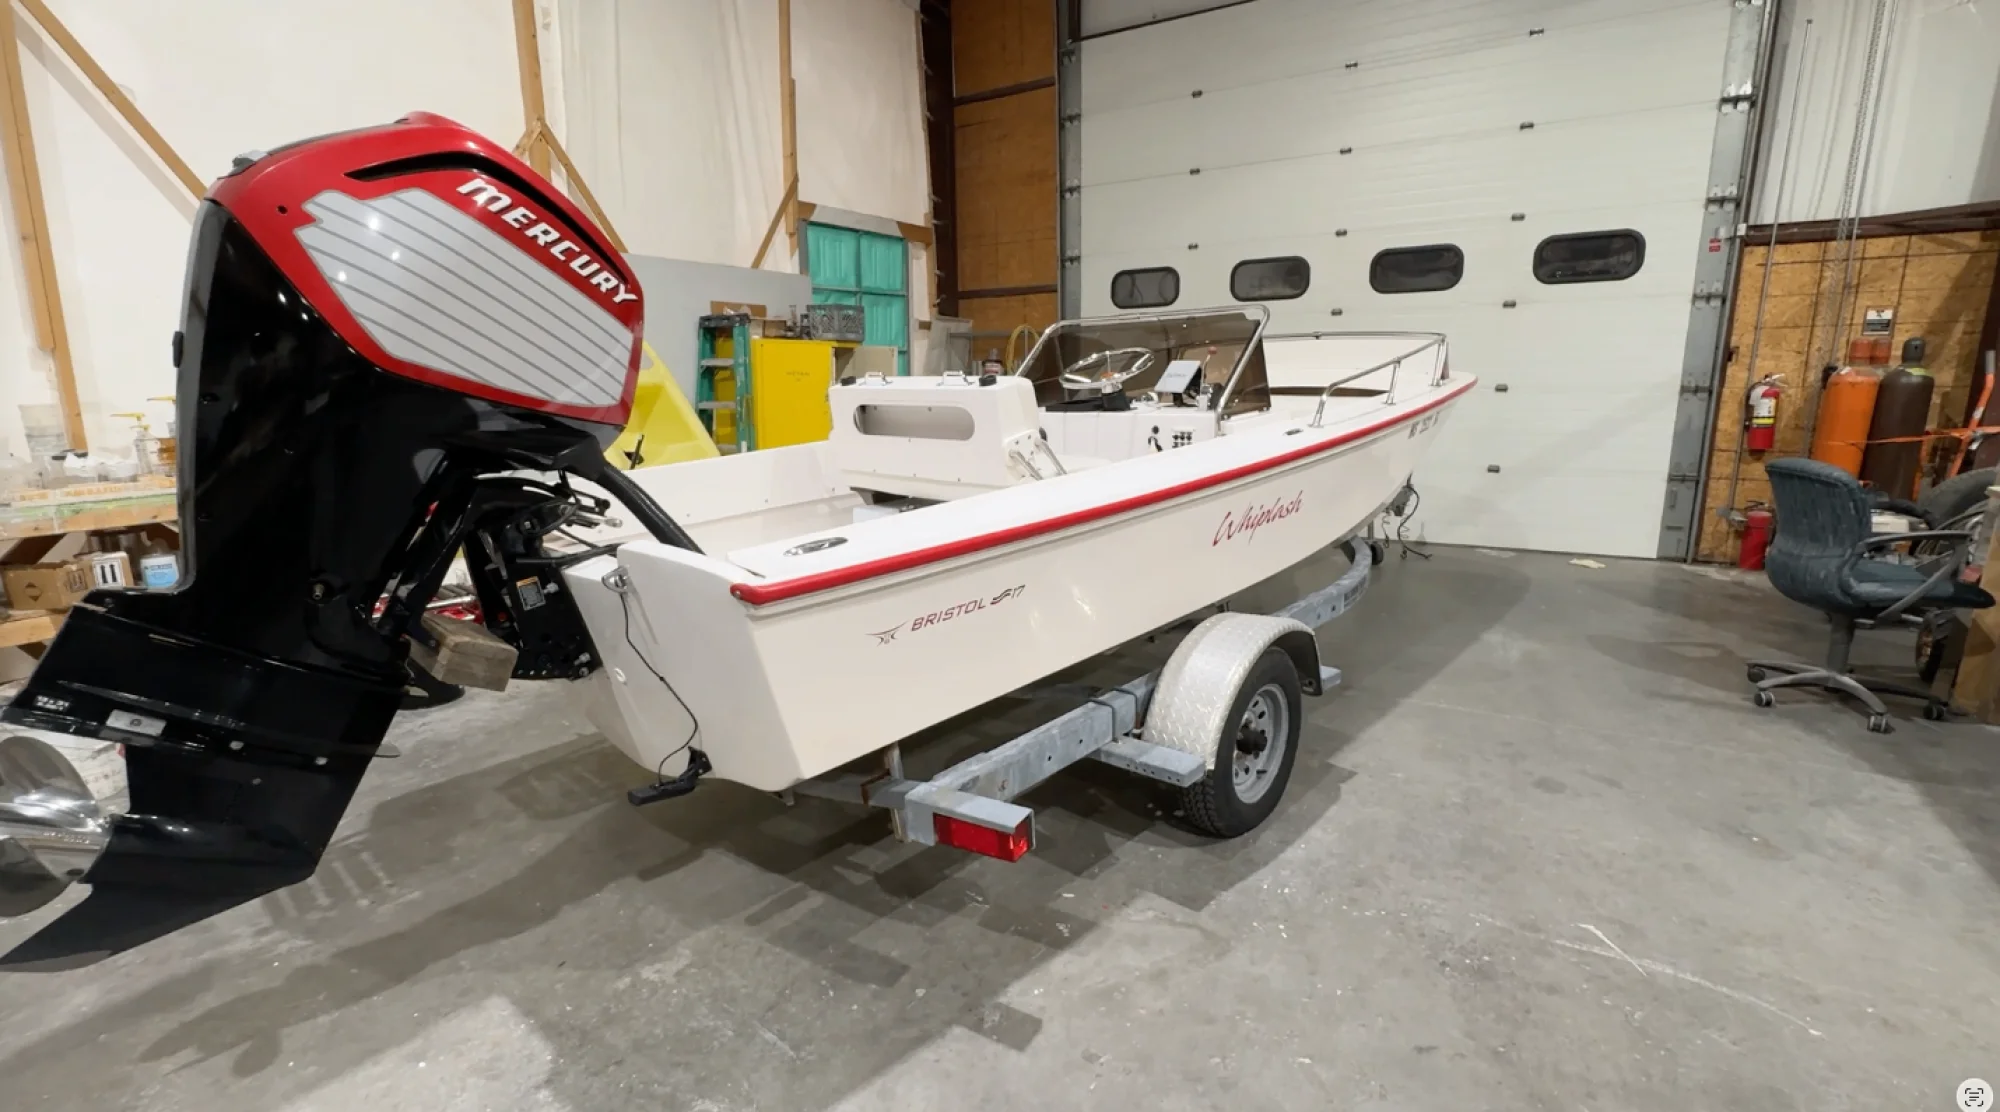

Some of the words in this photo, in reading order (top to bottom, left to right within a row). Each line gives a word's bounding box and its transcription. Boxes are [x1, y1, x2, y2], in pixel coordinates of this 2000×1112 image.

[456, 178, 638, 303] MERCURY
[1212, 490, 1303, 546] Whiplash
[911, 598, 986, 632] BRISTOL
